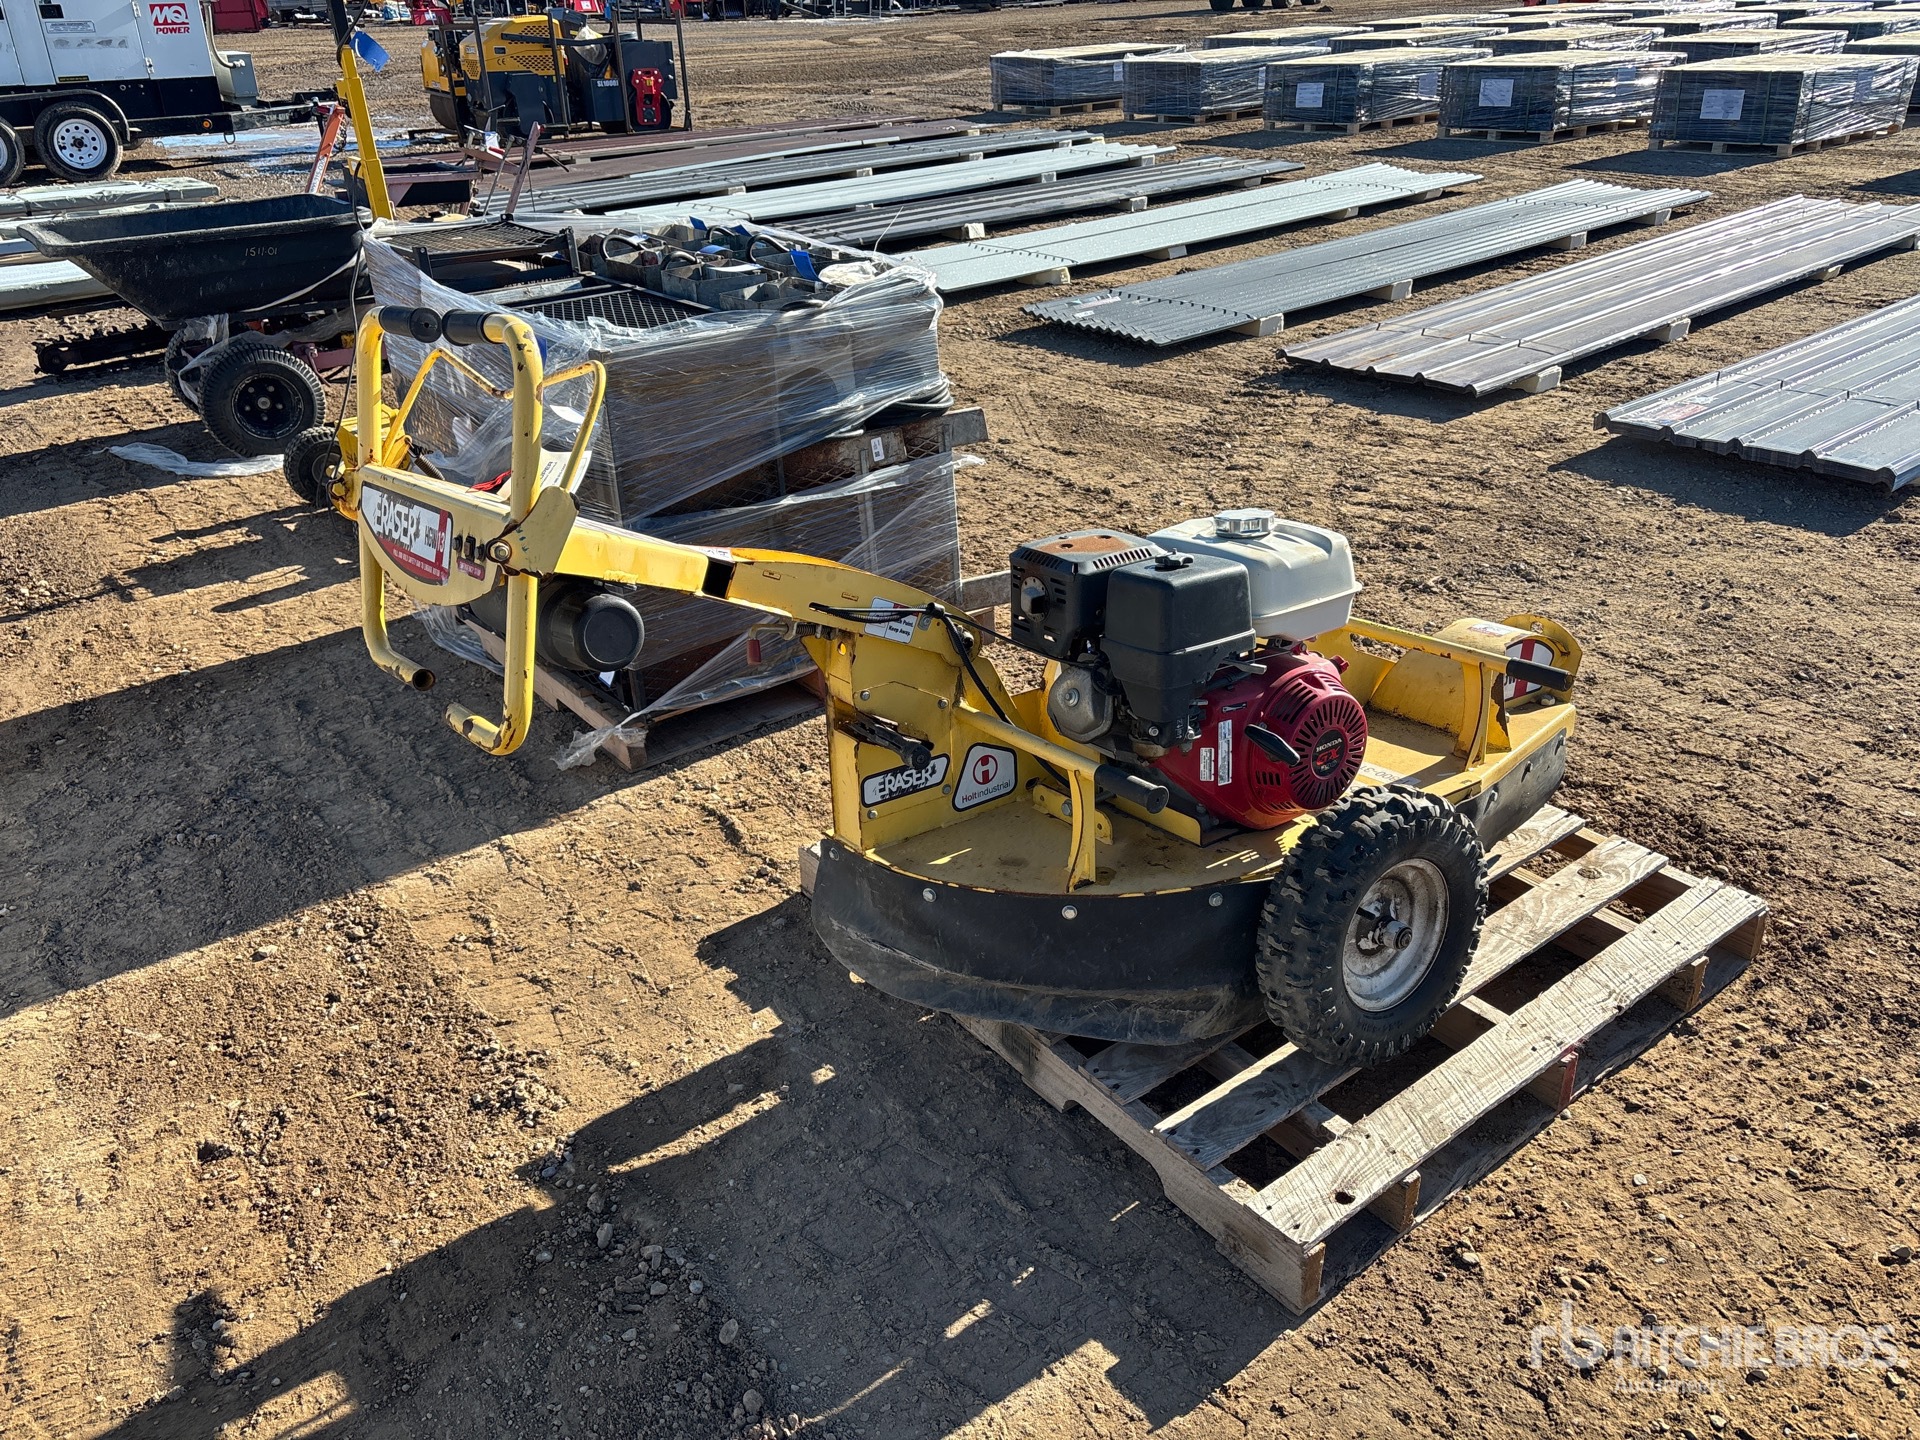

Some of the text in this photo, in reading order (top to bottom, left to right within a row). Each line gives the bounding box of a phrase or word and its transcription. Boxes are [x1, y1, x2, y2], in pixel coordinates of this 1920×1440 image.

[150, 4, 190, 25] MQ
[156, 26, 190, 35] POWER
[374, 494, 418, 547] ERASER
[1316, 737, 1343, 753] HONDA
[1316, 746, 1341, 766] GX
[876, 764, 932, 796] ERASER
